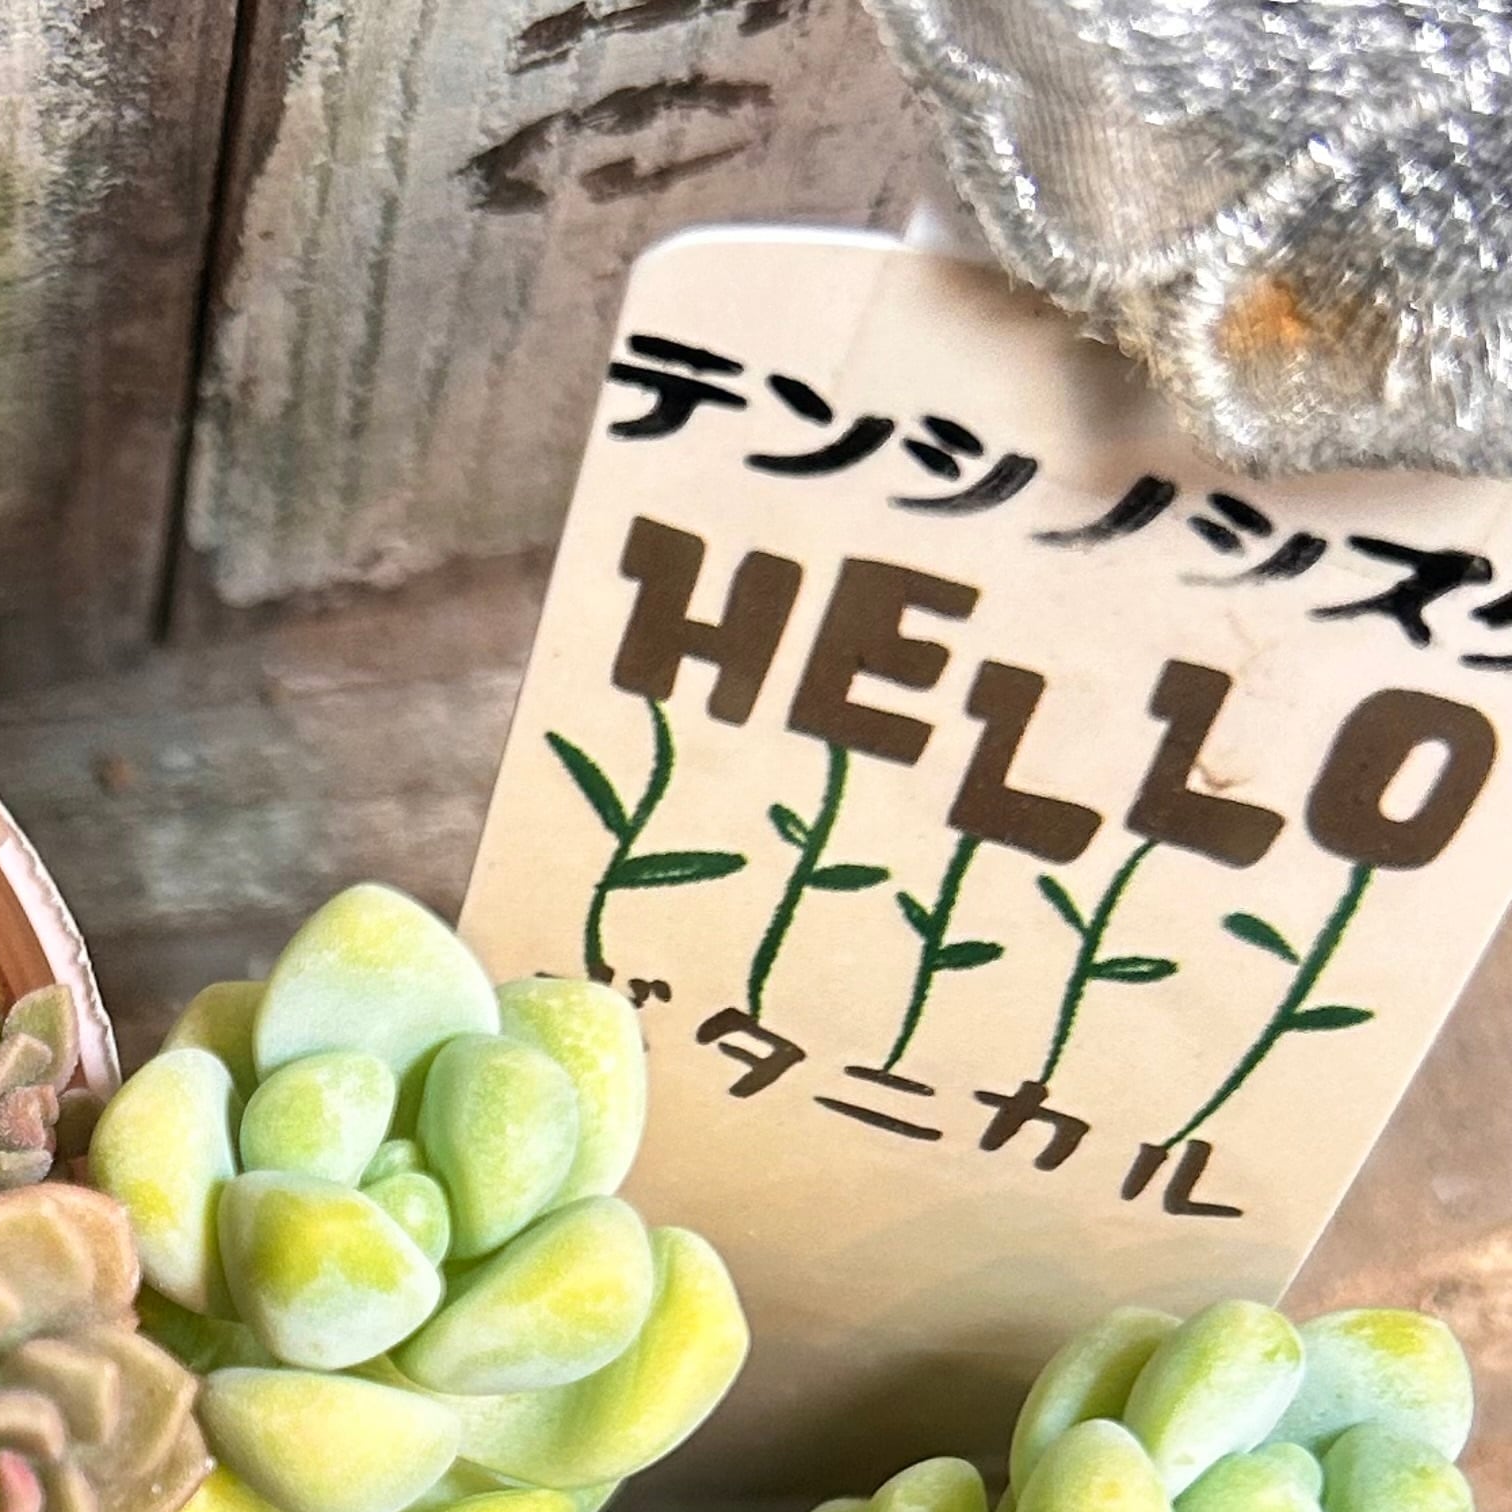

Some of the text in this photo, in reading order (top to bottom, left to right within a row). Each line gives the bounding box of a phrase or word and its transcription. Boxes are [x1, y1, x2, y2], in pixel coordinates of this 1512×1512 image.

[610, 514, 1500, 871] HELLO
[535, 971, 1245, 1218] タニカル
